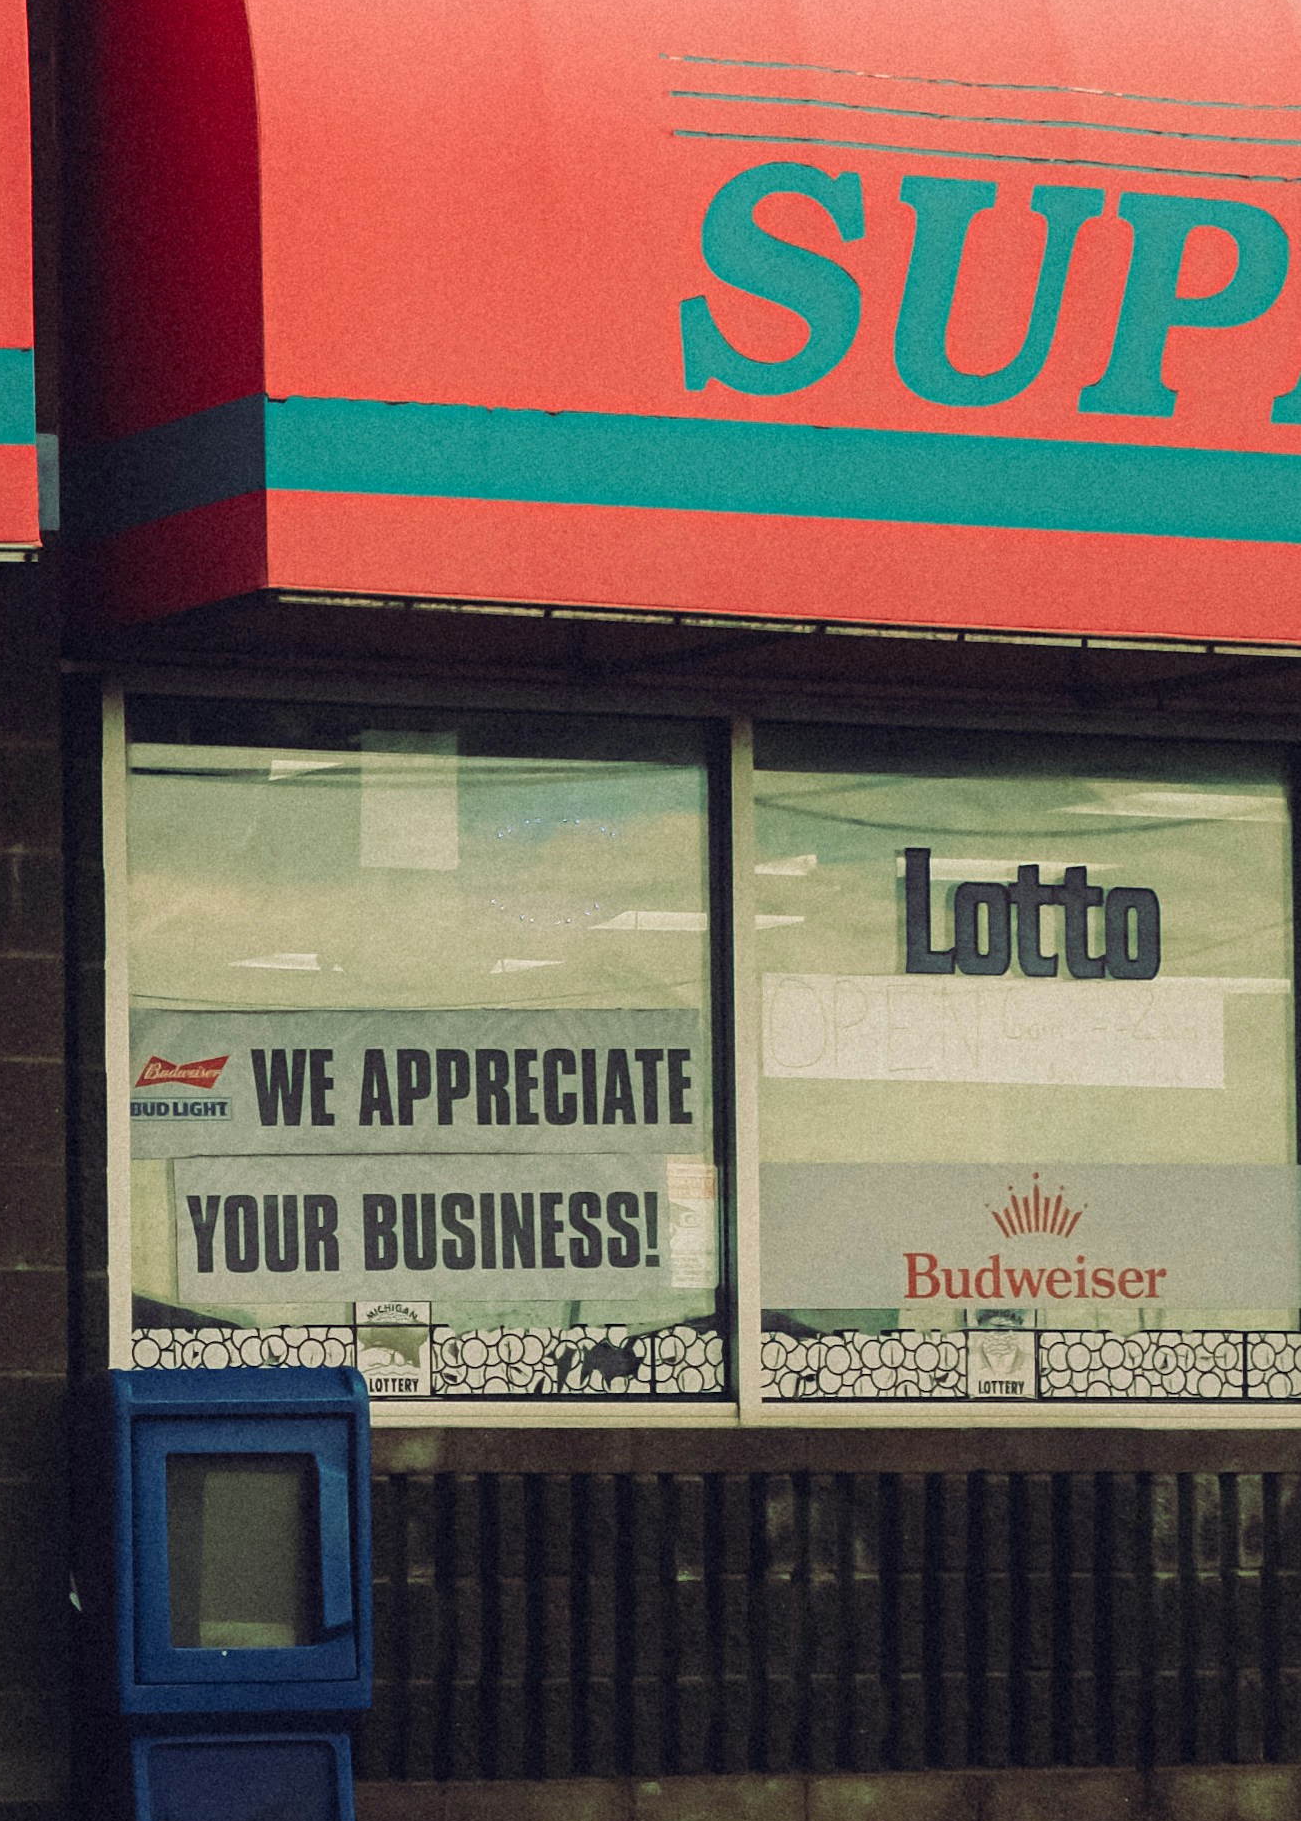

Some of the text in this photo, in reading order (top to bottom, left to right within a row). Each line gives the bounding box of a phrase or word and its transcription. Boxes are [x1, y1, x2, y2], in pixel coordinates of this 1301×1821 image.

[679, 161, 1301, 426] SUP
[904, 846, 1162, 981] Lotto
[769, 979, 986, 1072] OPEN
[144, 1062, 223, 1080] Budweiser
[251, 1046, 693, 1127] WE APPRECIATE
[130, 1101, 229, 1117] BUD LIGHT
[186, 1194, 341, 1274] YOUR
[362, 1191, 661, 1272] BUSINESS!
[903, 1252, 1167, 1301] Budweiser
[365, 1304, 419, 1321] MICHIGAN
[369, 1377, 419, 1393] LOTTERY
[978, 1380, 1025, 1395] LOTTERY
